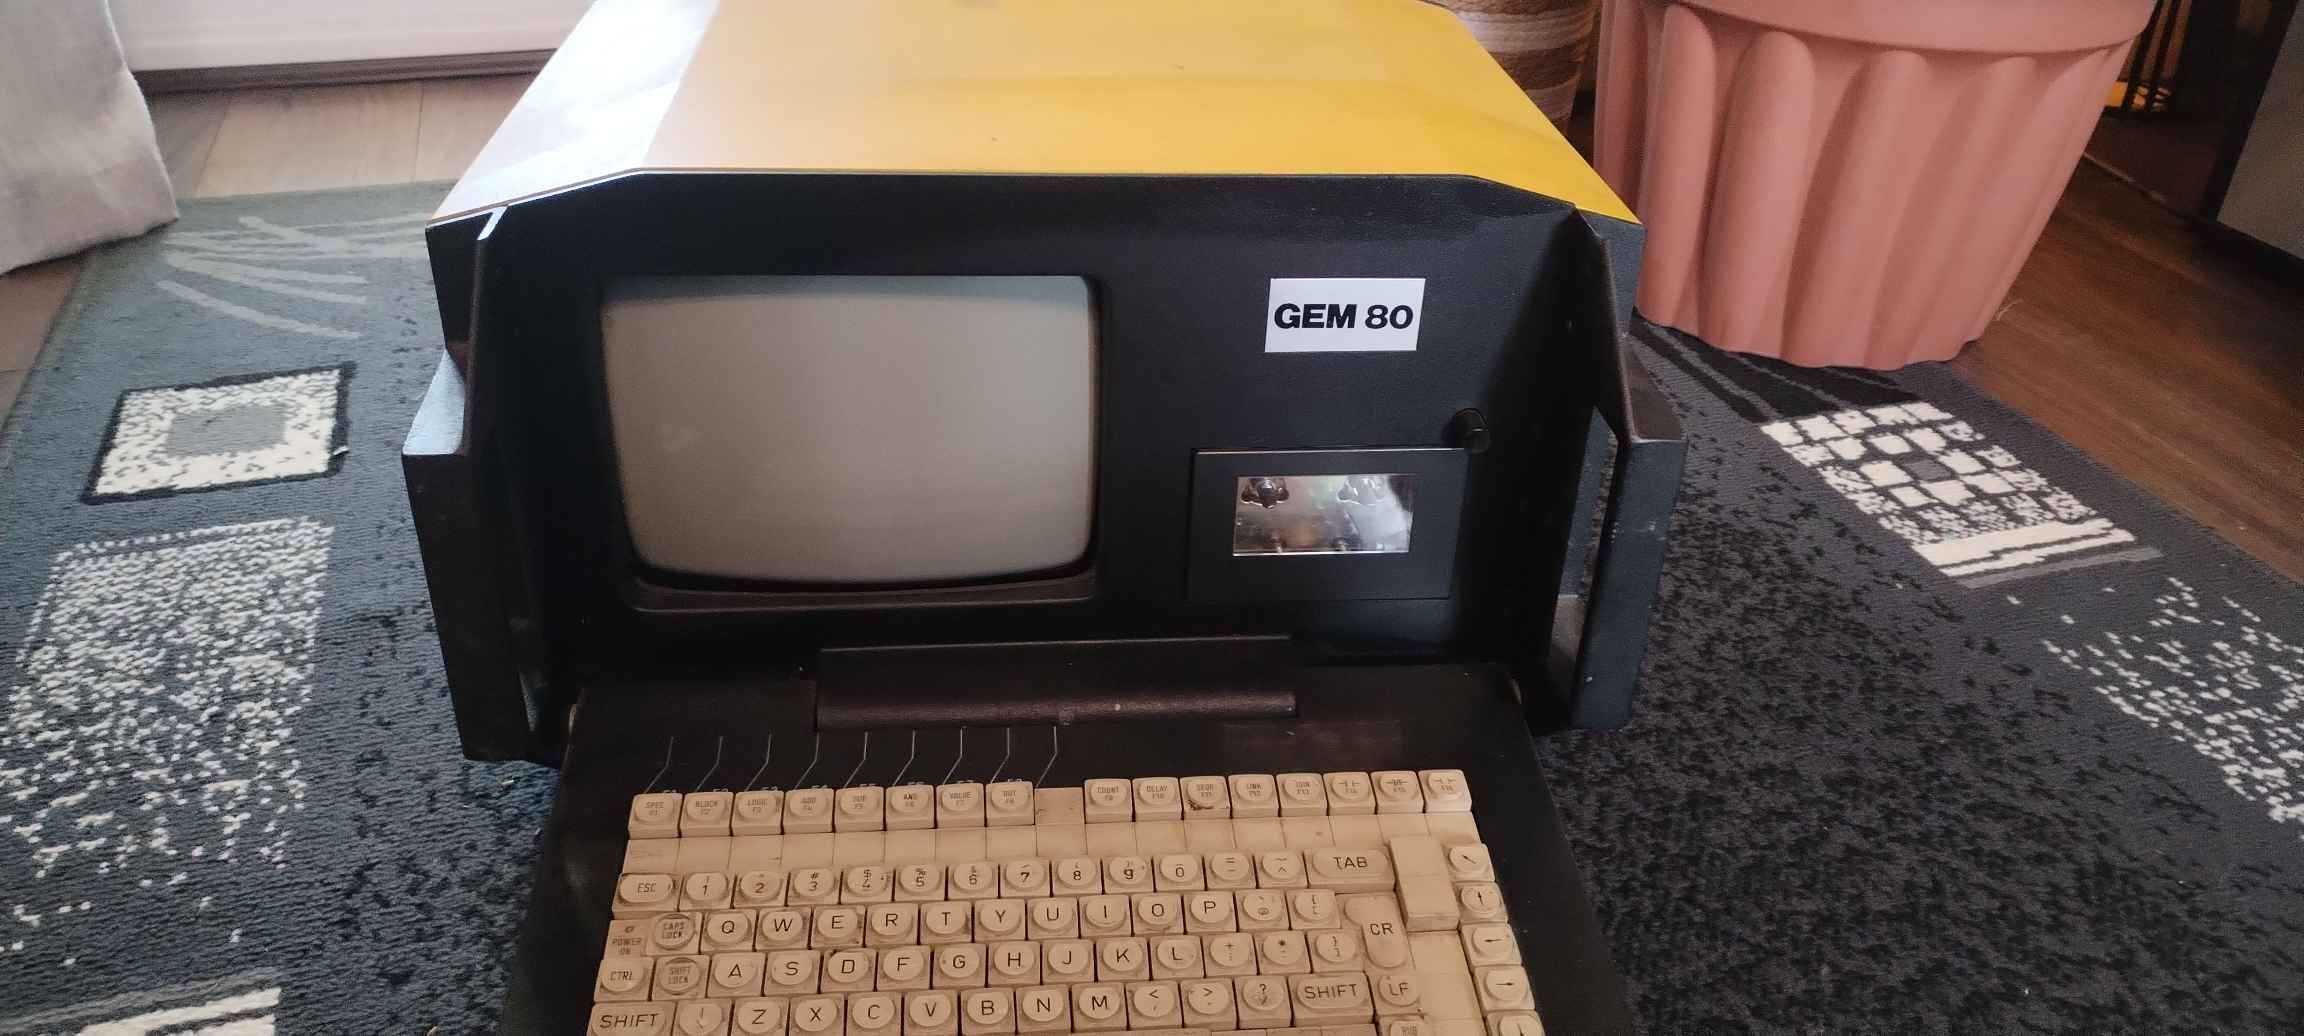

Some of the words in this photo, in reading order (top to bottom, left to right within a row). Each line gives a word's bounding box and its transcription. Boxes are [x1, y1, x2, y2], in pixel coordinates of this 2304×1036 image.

[1273, 303, 1357, 329] GEM
[1364, 304, 1414, 329] 80
[1333, 856, 1369, 869] TAB
[915, 876, 925, 888] 5
[969, 874, 978, 886] 6
[1020, 871, 1031, 883] 7
[1073, 870, 1082, 881] 8
[637, 882, 657, 894] ESC
[754, 882, 766, 894] 2
[809, 881, 819, 892] 3
[1046, 907, 1060, 922] U
[1151, 903, 1165, 917] O
[1204, 901, 1217, 914] P
[831, 915, 845, 929] E
[885, 913, 898, 928] R
[941, 912, 952, 926] T
[995, 909, 1006, 923] Y
[721, 920, 735, 934] Q
[774, 918, 793, 932] W
[1369, 922, 1394, 936] CR
[611, 937, 642, 946] POWER
[1007, 952, 1022, 967] H
[1062, 950, 1072, 965] J
[1116, 948, 1130, 963] K
[1172, 946, 1183, 961] L
[784, 961, 799, 976] S
[841, 959, 856, 974] D
[896, 956, 911, 971] F
[952, 954, 966, 969] G
[610, 970, 634, 981] CTRL
[669, 966, 691, 976] SHIFT
[727, 964, 743, 978] A
[1258, 983, 1268, 993] ?
[1304, 984, 1358, 999] SHIFT
[1389, 982, 1410, 997] LF
[925, 1001, 937, 1017] V
[981, 1000, 995, 1015] B
[1036, 997, 1051, 1013] N
[1091, 995, 1108, 1011] M
[752, 1009, 768, 1025] Z
[809, 1007, 822, 1022] X
[867, 1004, 881, 1020] C
[599, 1013, 660, 1030] SHIFT
